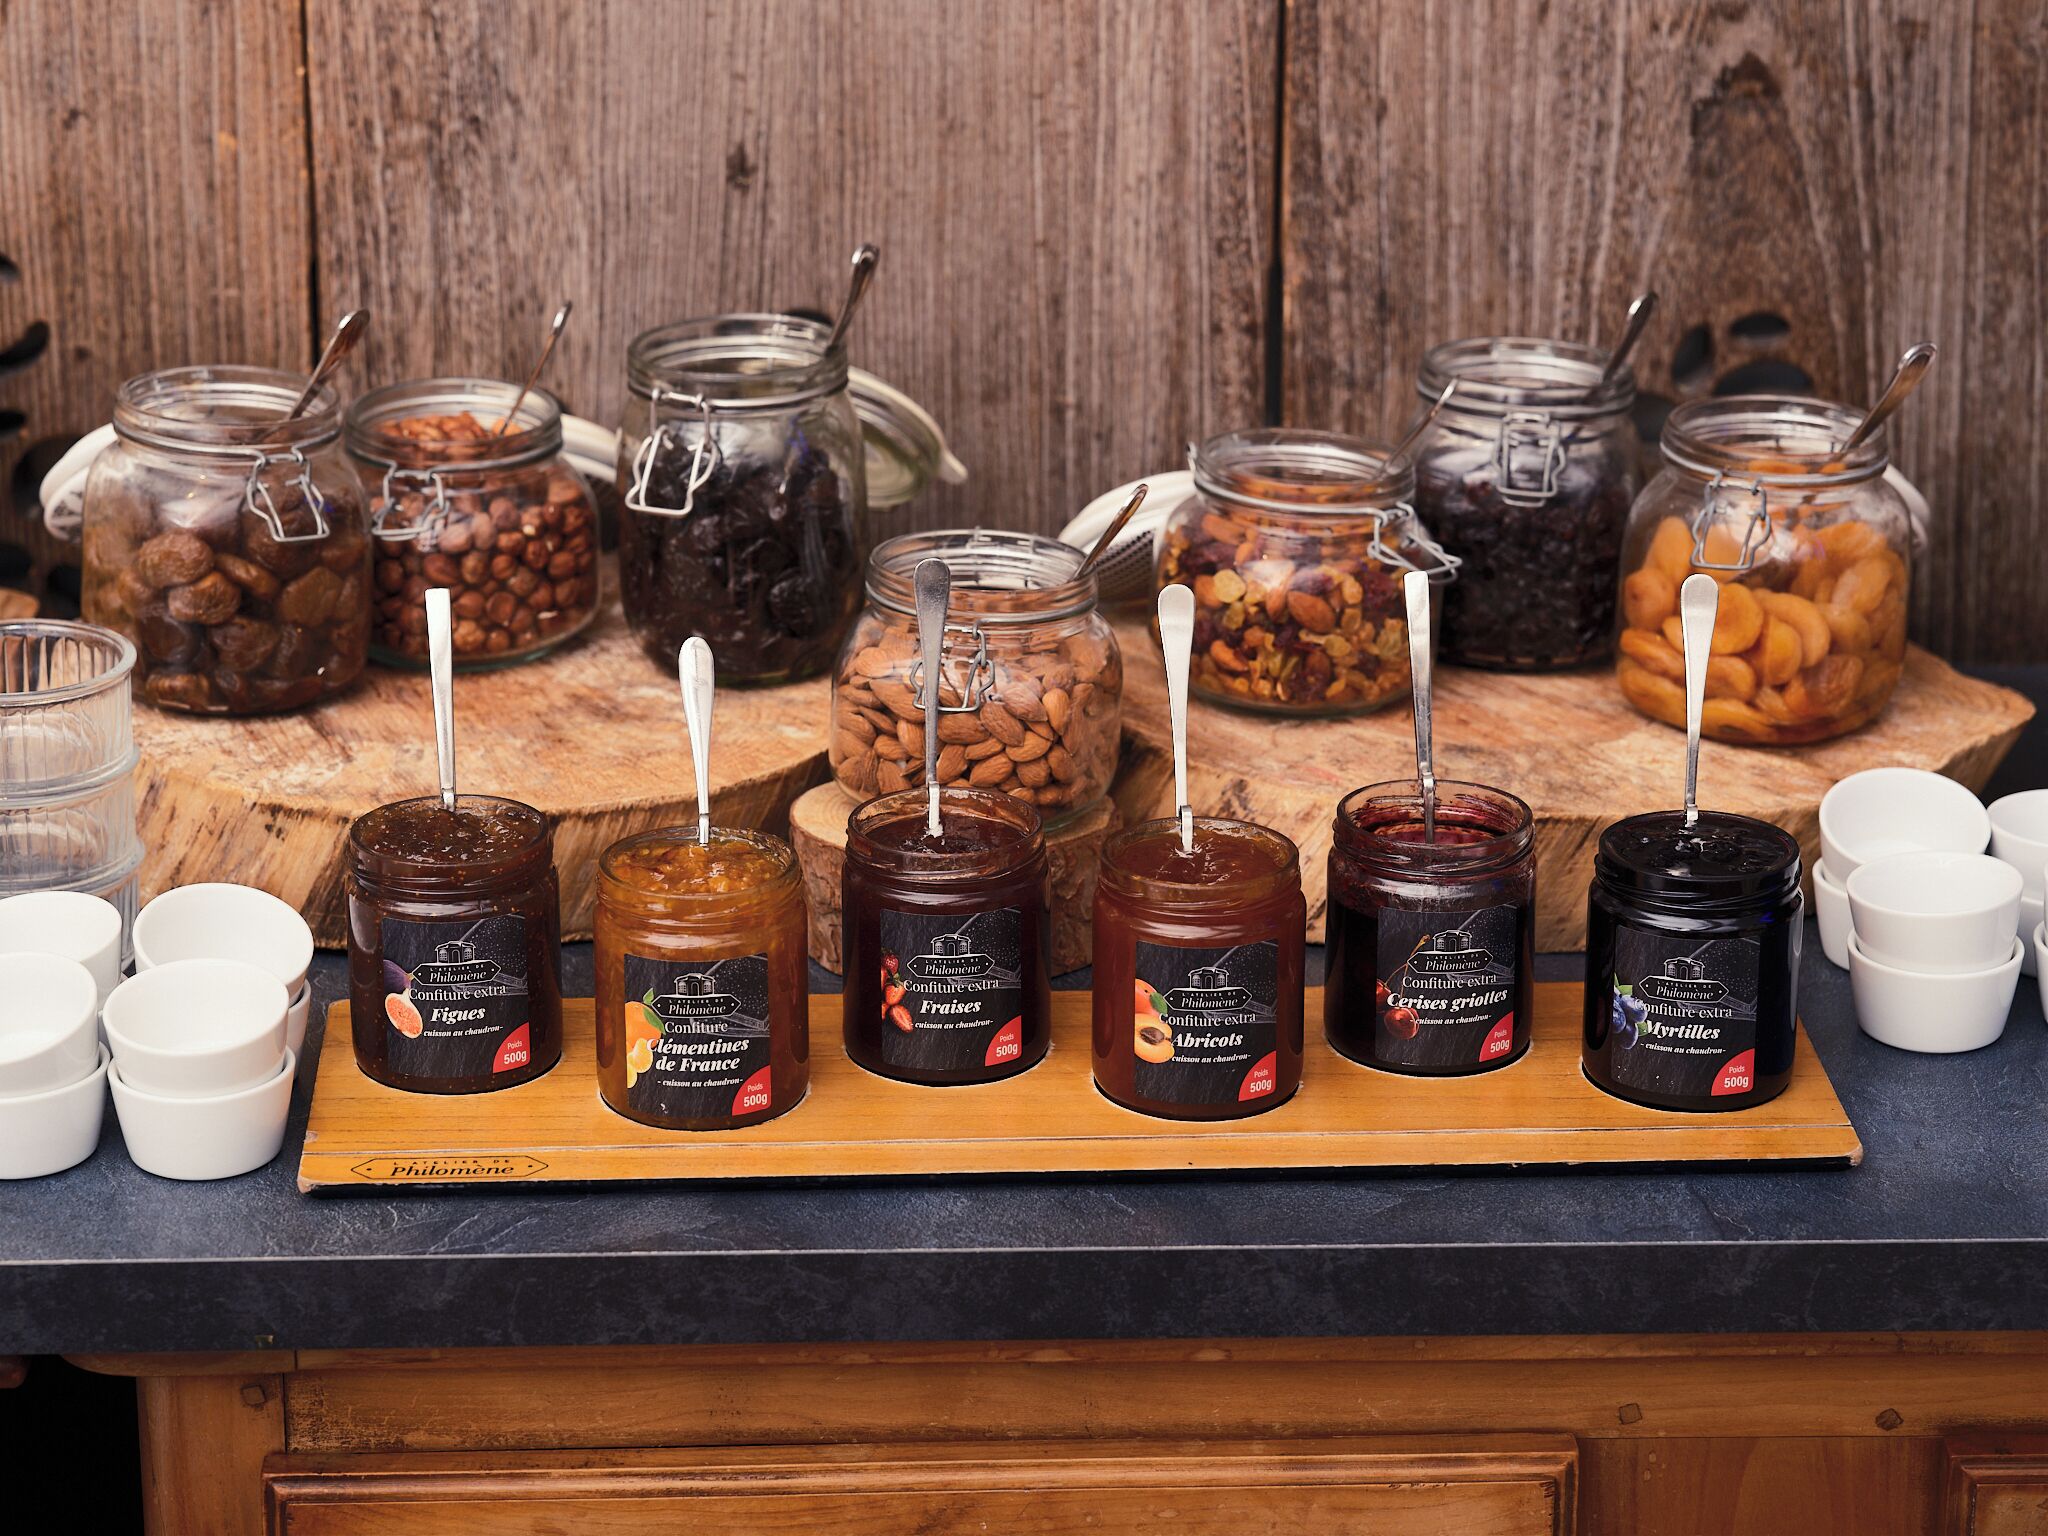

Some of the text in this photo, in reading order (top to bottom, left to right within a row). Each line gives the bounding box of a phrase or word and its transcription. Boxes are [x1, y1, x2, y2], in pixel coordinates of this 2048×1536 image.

[925, 963, 980, 975] Philomène
[1426, 960, 1480, 971] Philomène
[430, 971, 487, 982] Philomène
[1402, 973, 1496, 989] Confiture extra
[409, 984, 506, 1001] Confiture extra
[903, 978, 999, 994] Confiture extra
[1657, 987, 1714, 1000] Philomène
[919, 1000, 981, 1015] Fraises
[1181, 997, 1238, 1008] Philomène
[1387, 990, 1508, 1012] Cerises griottes
[431, 1007, 485, 1024] Figues
[669, 1004, 726, 1015] Philomène
[1699, 1007, 1732, 1019] extra
[1159, 1012, 1256, 1027] Confiture extra
[1416, 1017, 1443, 1025] cuisson
[424, 1029, 451, 1037] cuisson
[664, 1021, 728, 1034] Confiture
[1646, 1020, 1720, 1040] Myrtilles
[999, 1033, 1014, 1043] Poids
[1171, 1033, 1243, 1048] Abricots
[1494, 1030, 1507, 1039] Poids
[507, 1040, 522, 1049] Poids
[646, 1038, 749, 1055] Clémentines
[996, 1043, 1018, 1057] 500g
[1490, 1039, 1510, 1053] 500g
[1646, 1043, 1672, 1053] cuisson
[504, 1050, 527, 1064] 500g
[1172, 1055, 1200, 1063] cuisson
[656, 1056, 740, 1072] de France
[1729, 1065, 1745, 1073] Poids
[1254, 1069, 1268, 1078] Poids
[663, 1079, 690, 1087] cuisson
[747, 1083, 763, 1093] Poids
[1250, 1079, 1272, 1093] 500g
[1724, 1075, 1748, 1088] 500g
[743, 1093, 767, 1107] 500g
[390, 1165, 514, 1176] Philomène
